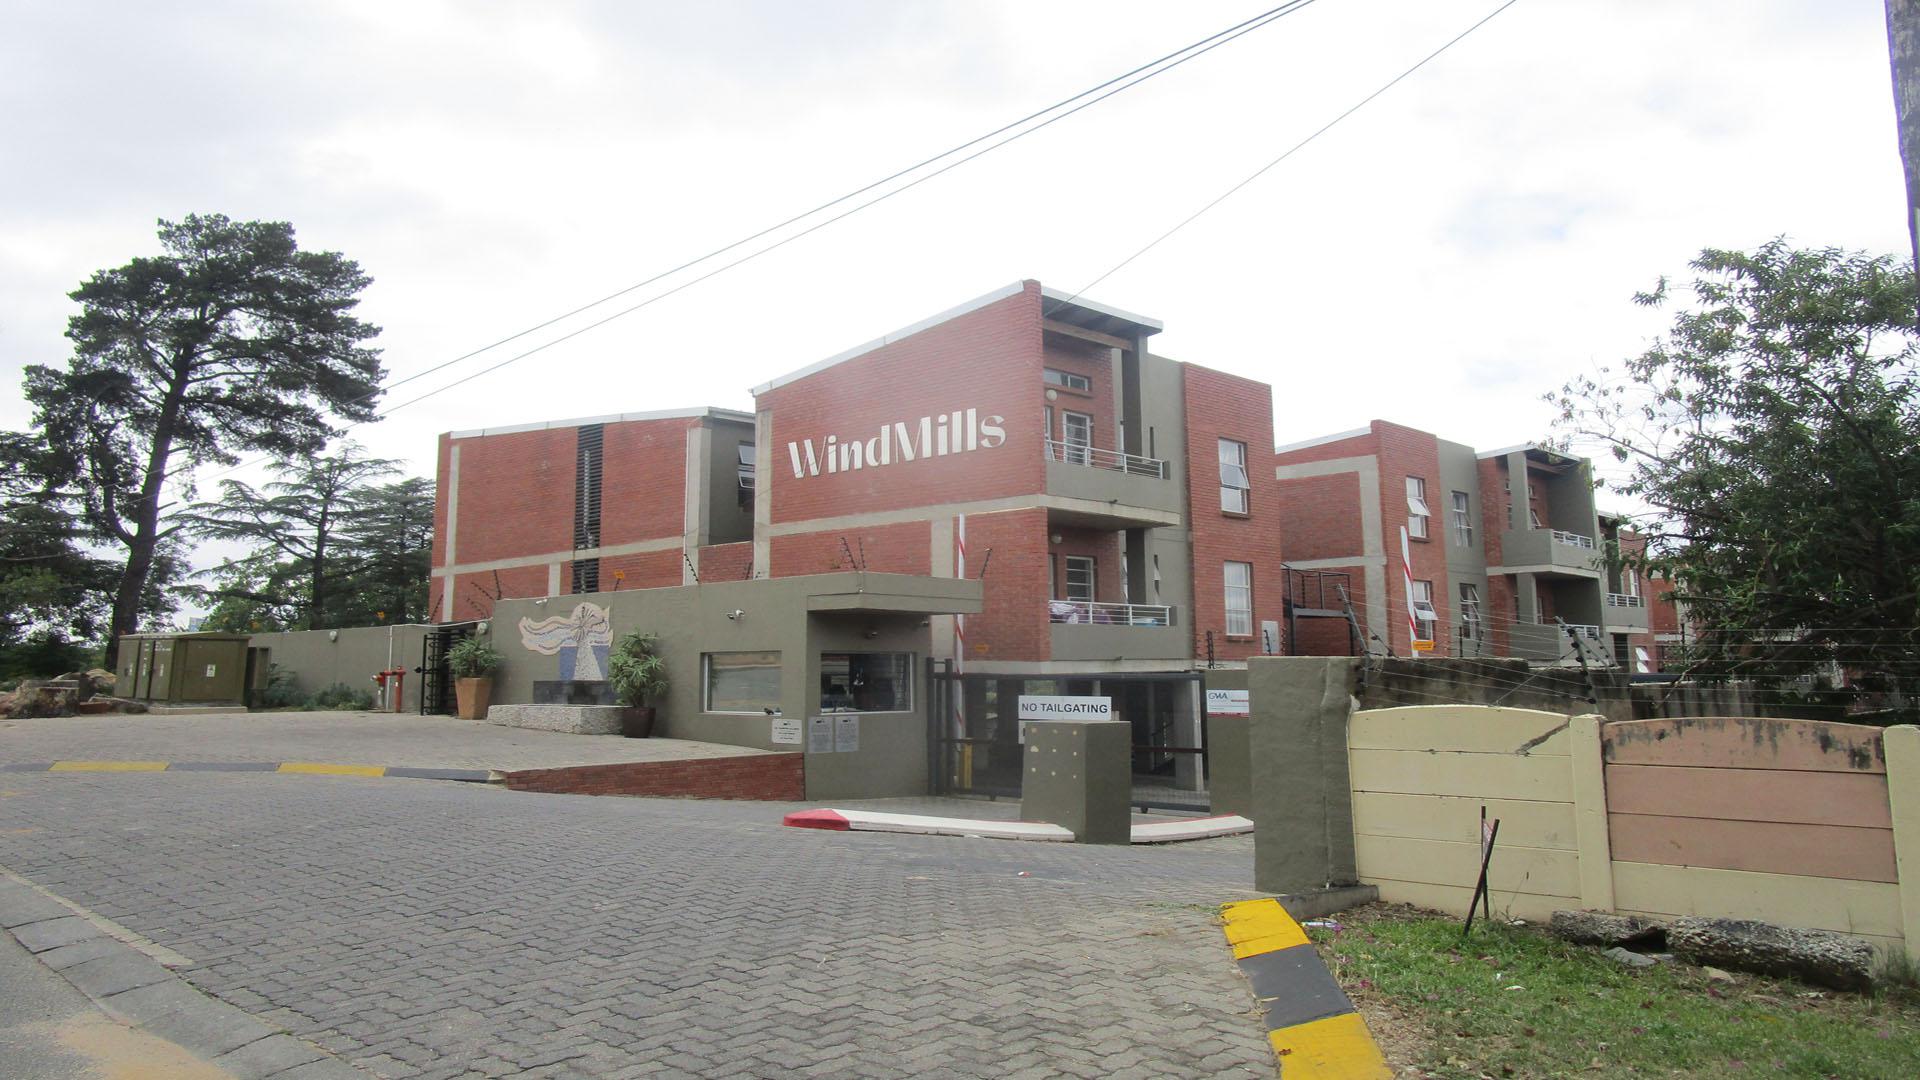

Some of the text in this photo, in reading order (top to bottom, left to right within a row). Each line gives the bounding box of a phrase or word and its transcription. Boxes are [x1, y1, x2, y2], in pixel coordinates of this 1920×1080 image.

[788, 408, 1006, 478] WindMills
[1021, 703, 1108, 714] NO TAILGATING
